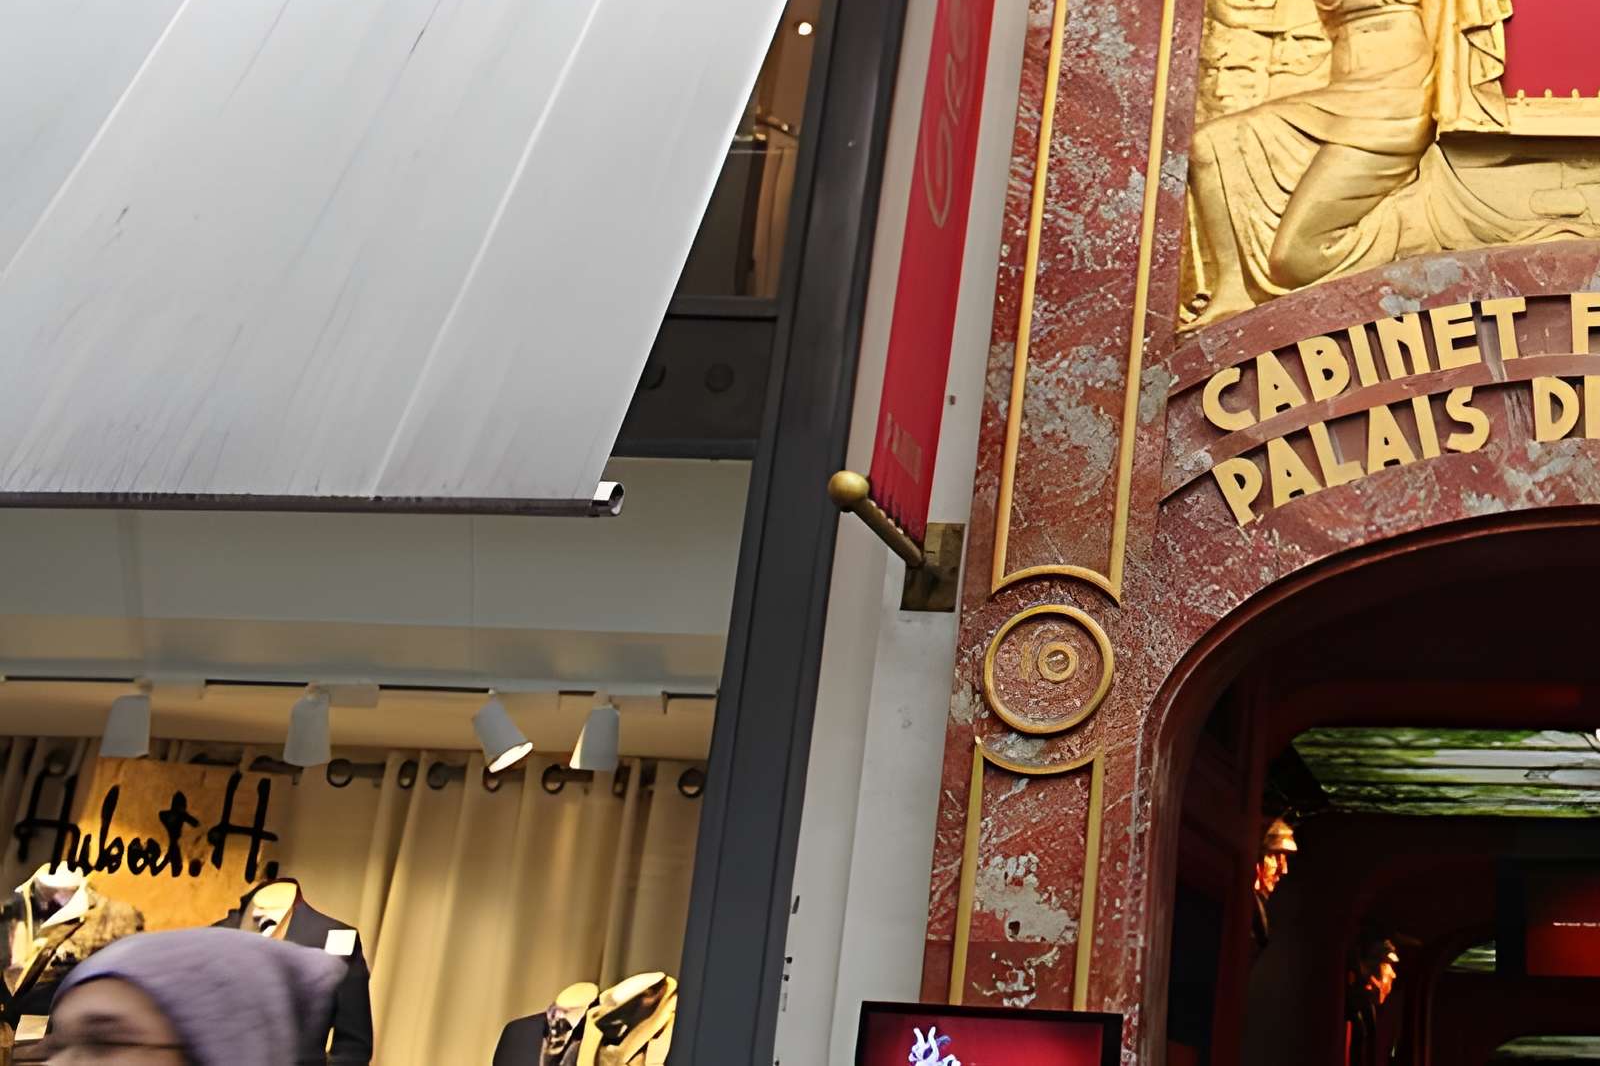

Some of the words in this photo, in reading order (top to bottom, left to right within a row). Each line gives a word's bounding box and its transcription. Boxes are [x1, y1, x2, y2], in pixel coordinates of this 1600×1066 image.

[1202, 296, 1527, 431] CABINET
[1212, 386, 1491, 528] PALAIS
[207, 770, 279, 883] H.
